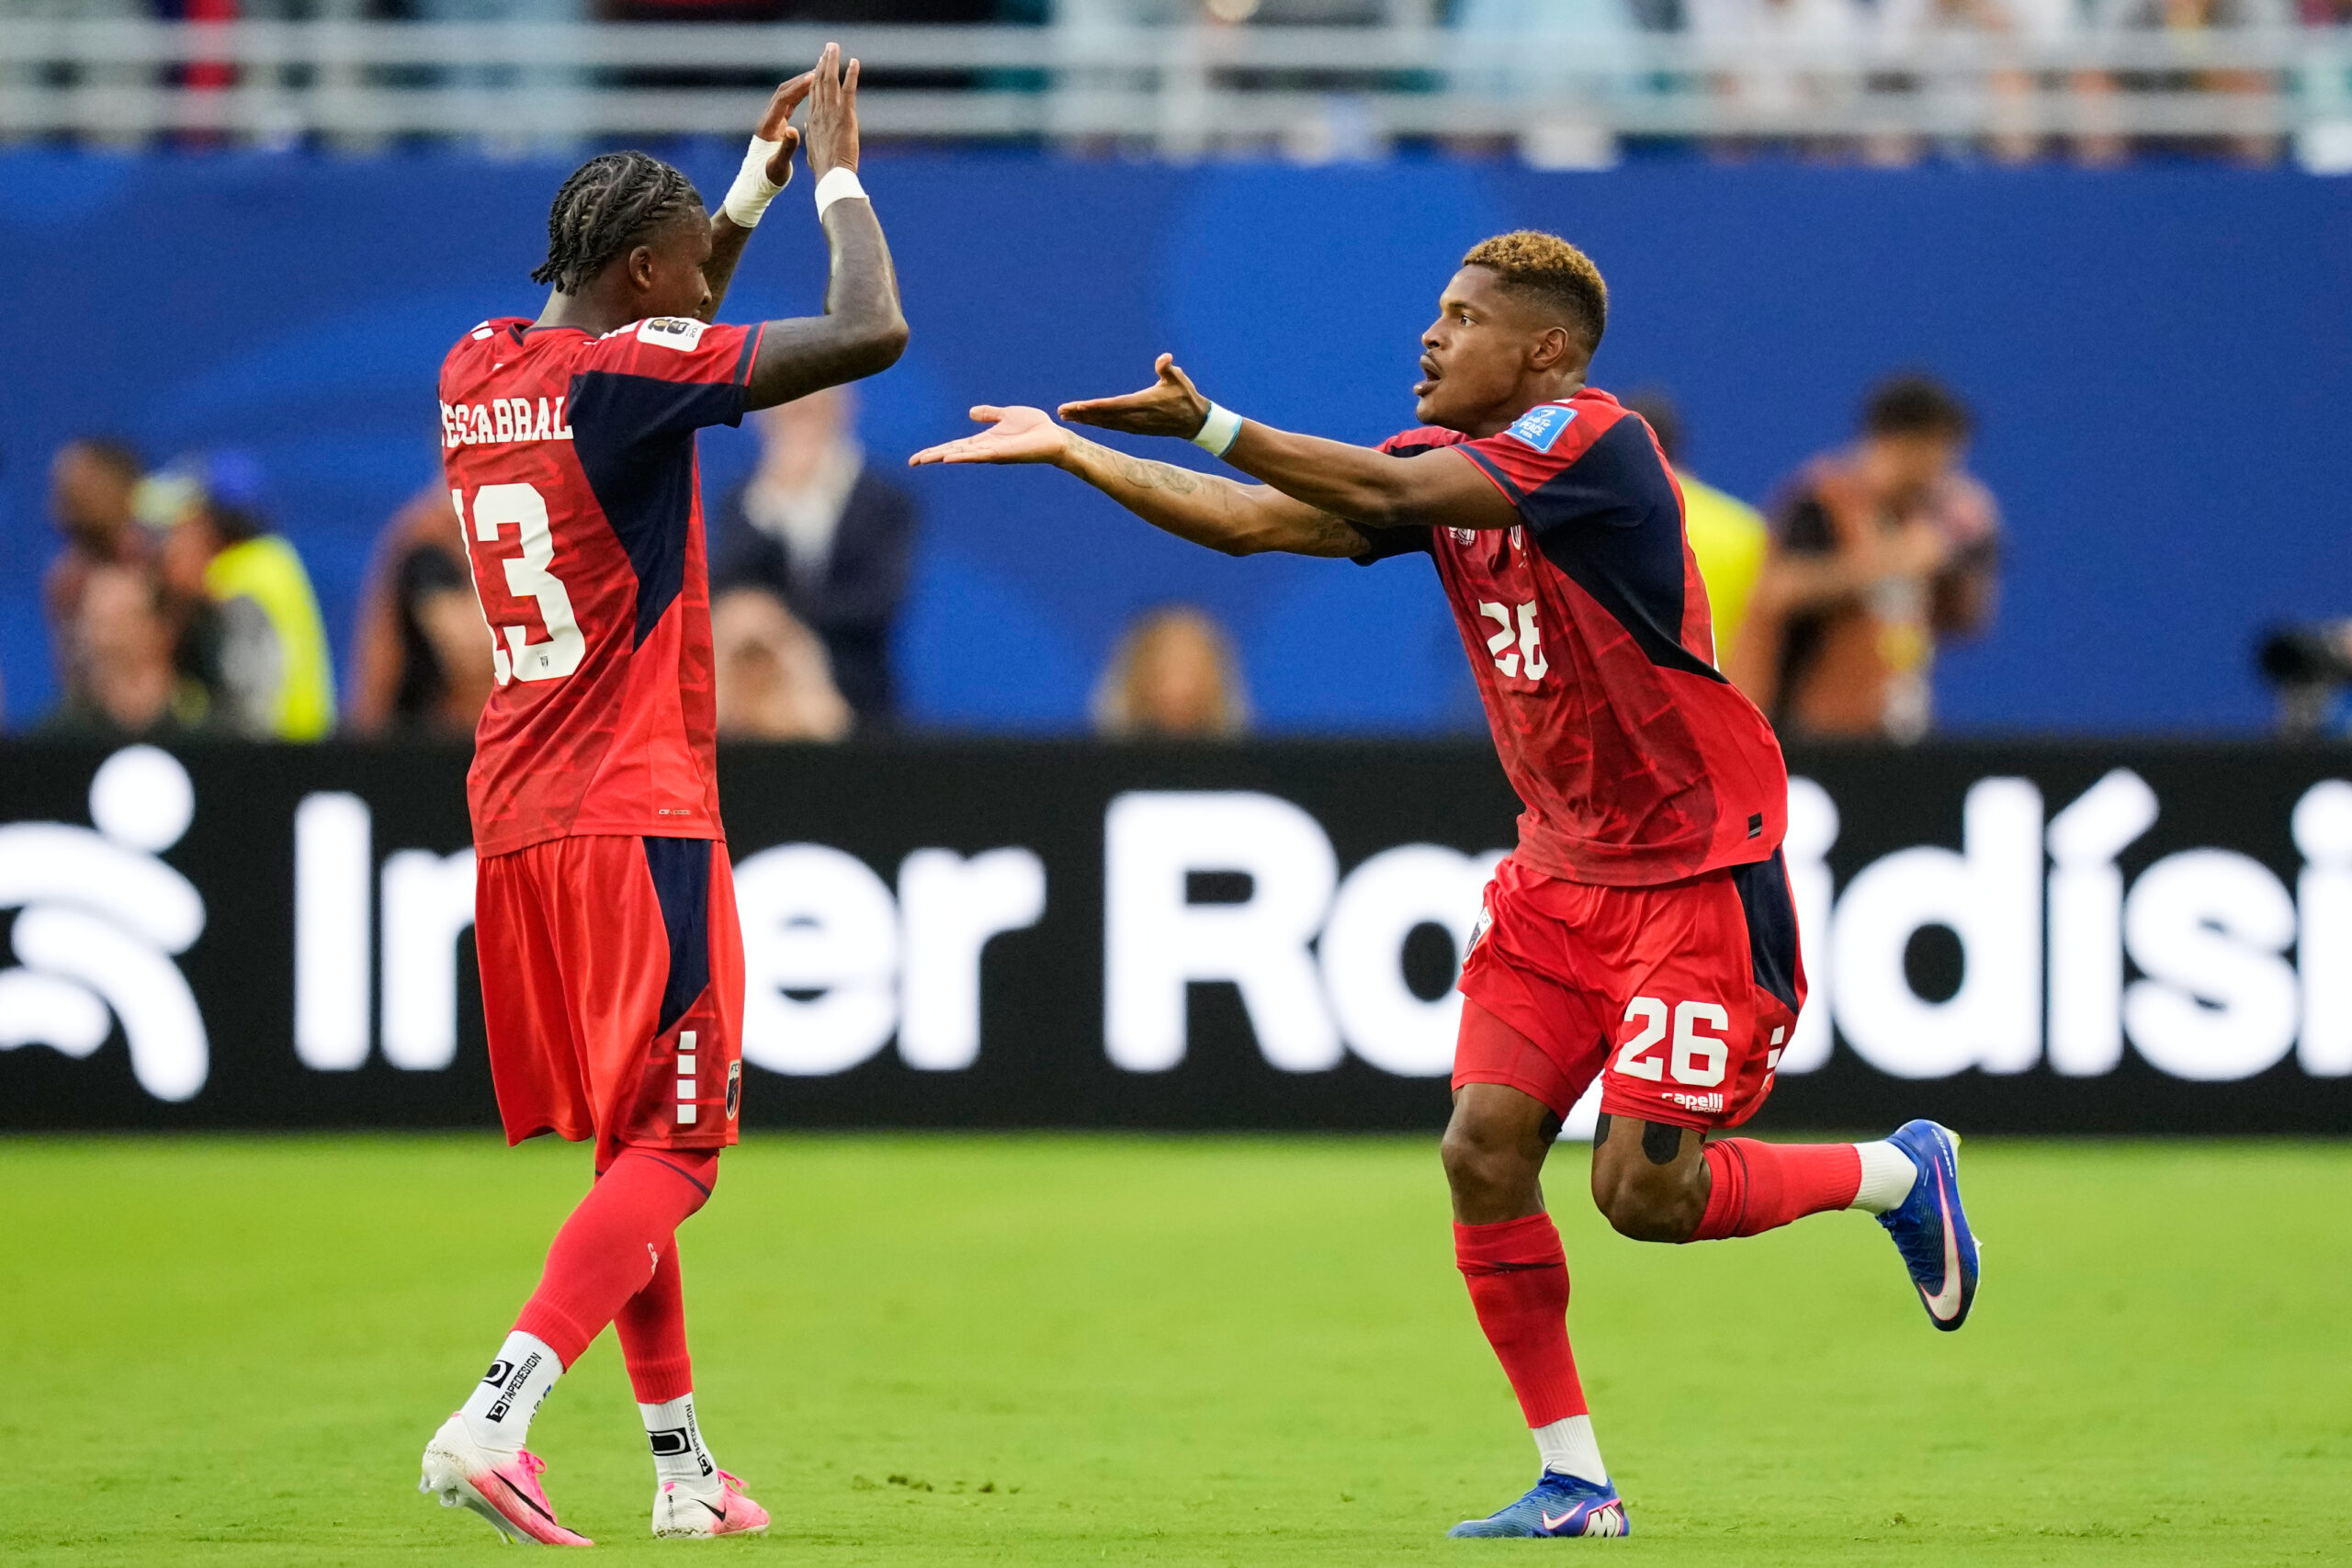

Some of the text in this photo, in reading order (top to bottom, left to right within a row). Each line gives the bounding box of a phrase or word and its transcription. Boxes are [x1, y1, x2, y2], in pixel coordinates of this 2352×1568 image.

[1519, 422, 1545, 436] PEACE
[1478, 598, 1549, 681] 26
[293, 768, 2352, 1139] Iner Raidísi
[1613, 996, 1729, 1087] 26
[1661, 1092, 1724, 1110] capelli
[501, 1351, 542, 1404] TAPEDESIGN
[685, 1404, 701, 1458] TAPEDESIGN
